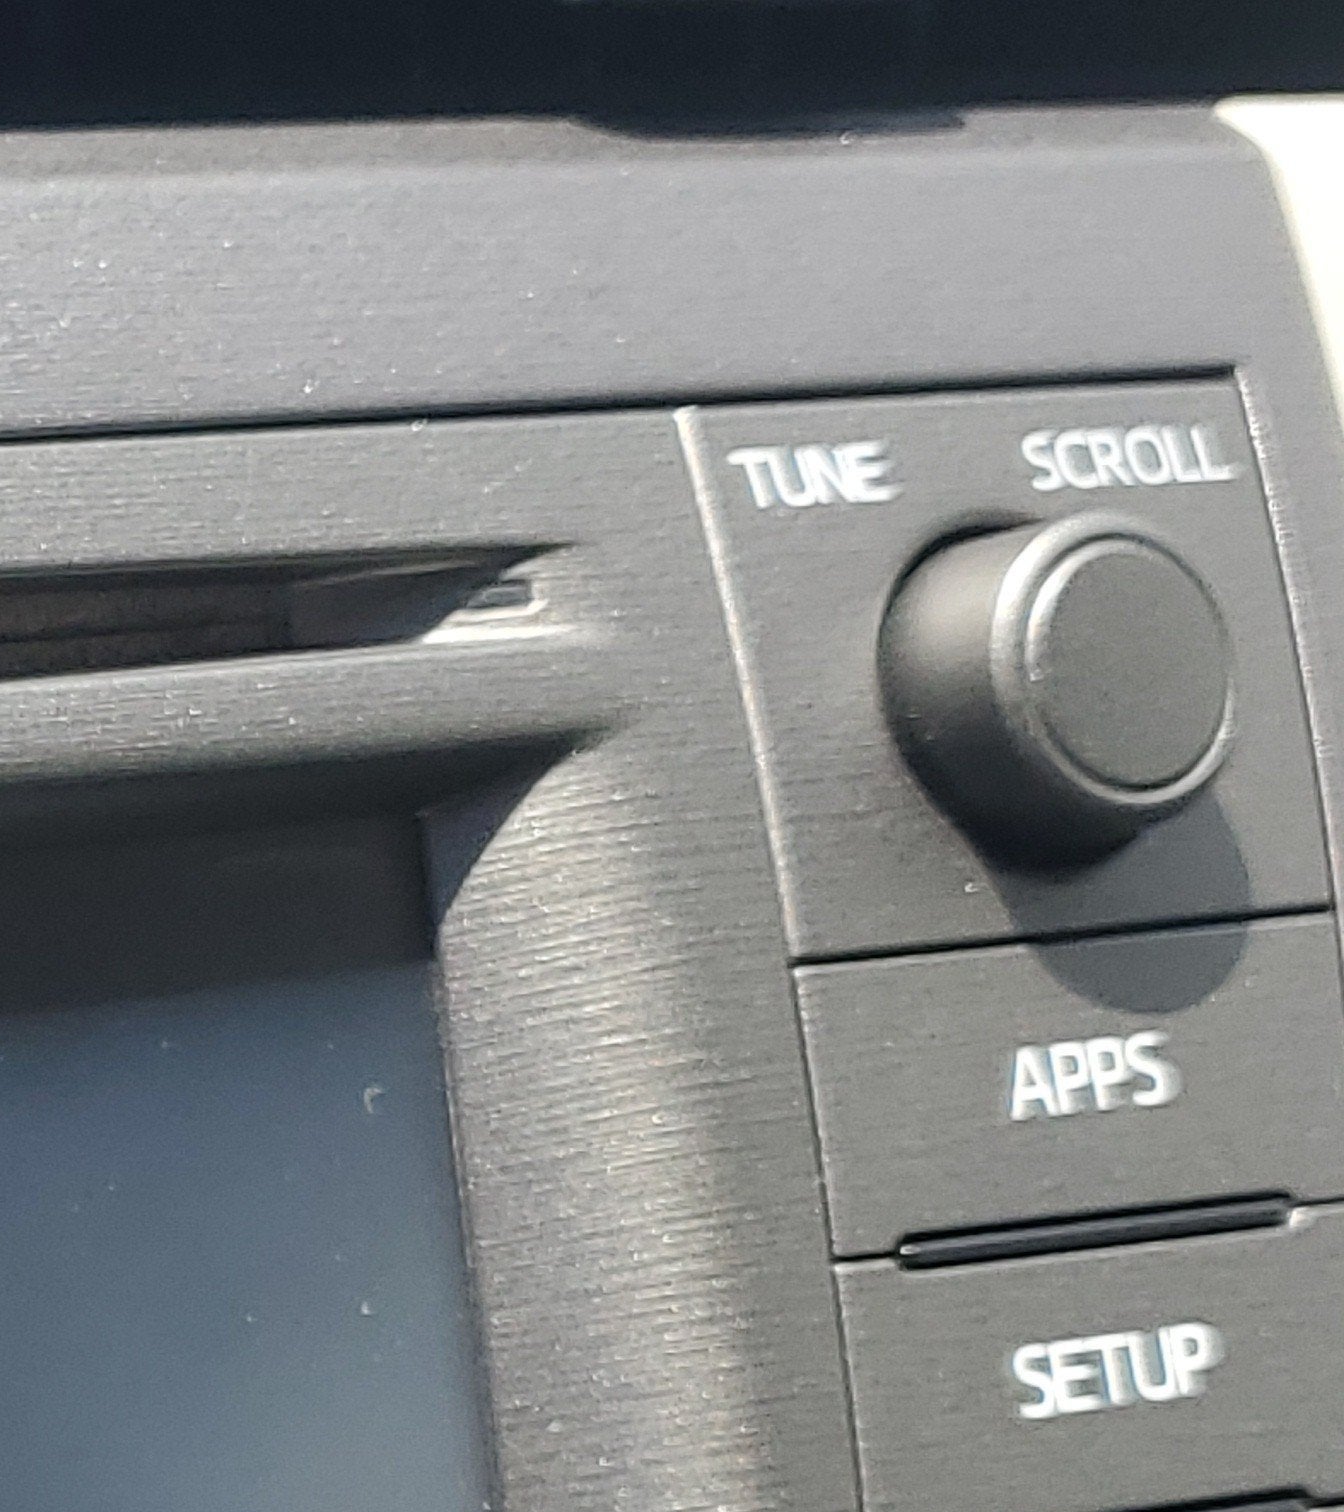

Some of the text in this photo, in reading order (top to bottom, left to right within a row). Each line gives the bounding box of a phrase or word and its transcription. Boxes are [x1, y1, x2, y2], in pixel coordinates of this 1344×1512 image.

[726, 439, 904, 508] TUNE
[1020, 423, 1240, 491] SCROLL
[1010, 1031, 1182, 1121] APPS
[1011, 1322, 1225, 1419] SETUP
